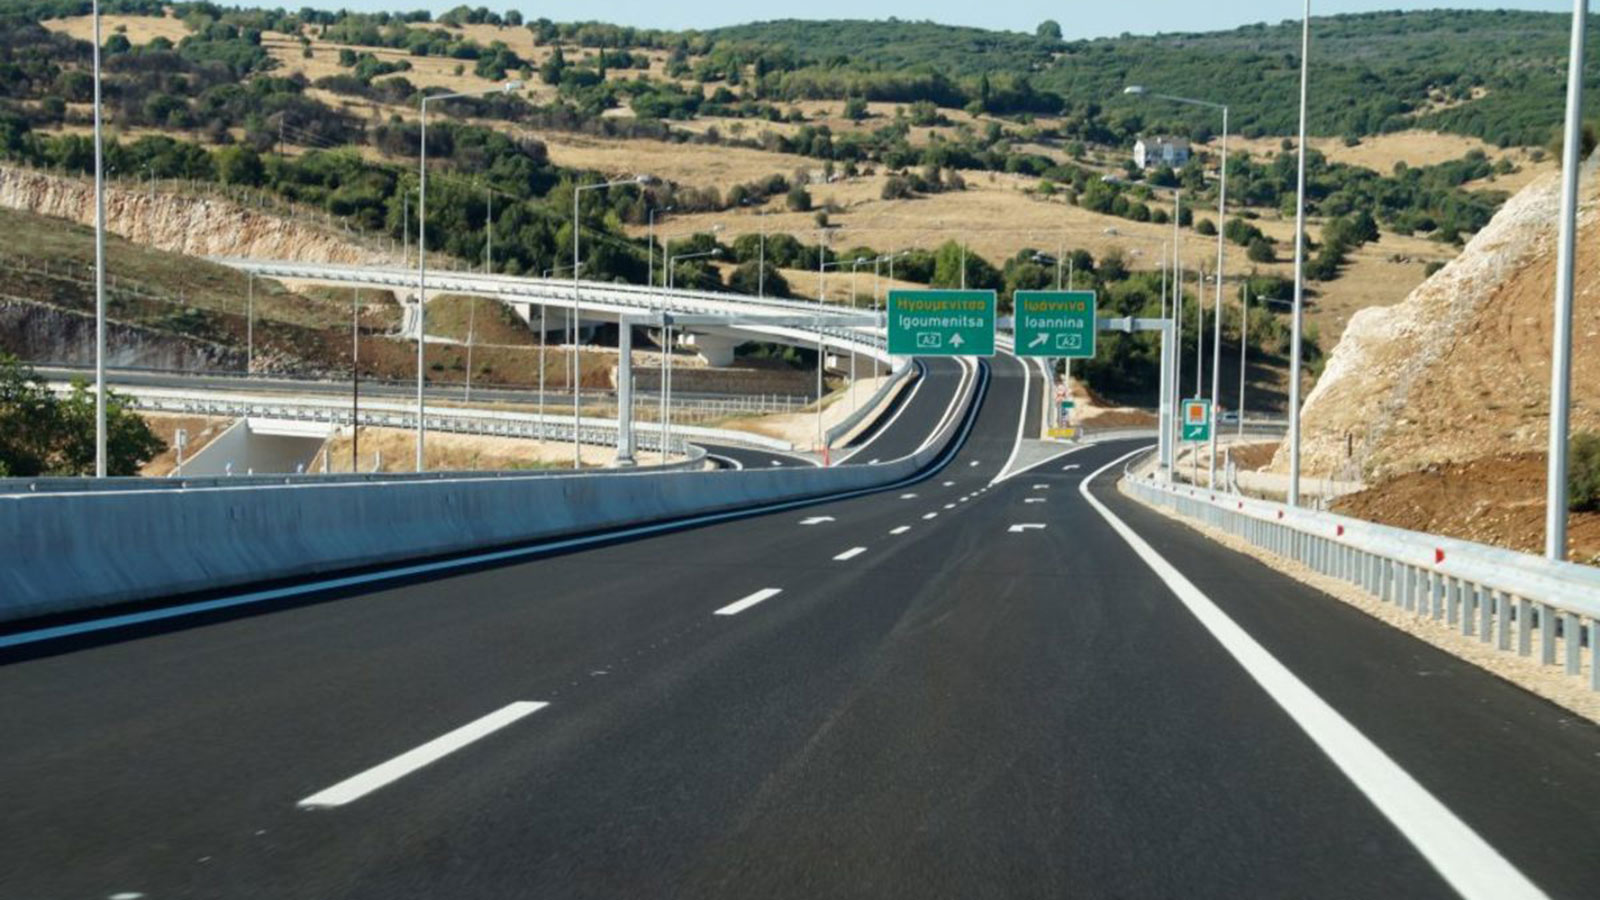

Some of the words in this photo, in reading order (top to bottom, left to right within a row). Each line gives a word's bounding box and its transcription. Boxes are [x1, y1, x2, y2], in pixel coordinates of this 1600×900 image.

[899, 314, 984, 329] Igoumenitsa
[1025, 315, 1084, 328] Ioannina
[922, 335, 937, 345] A2
[1061, 336, 1077, 346] A2
